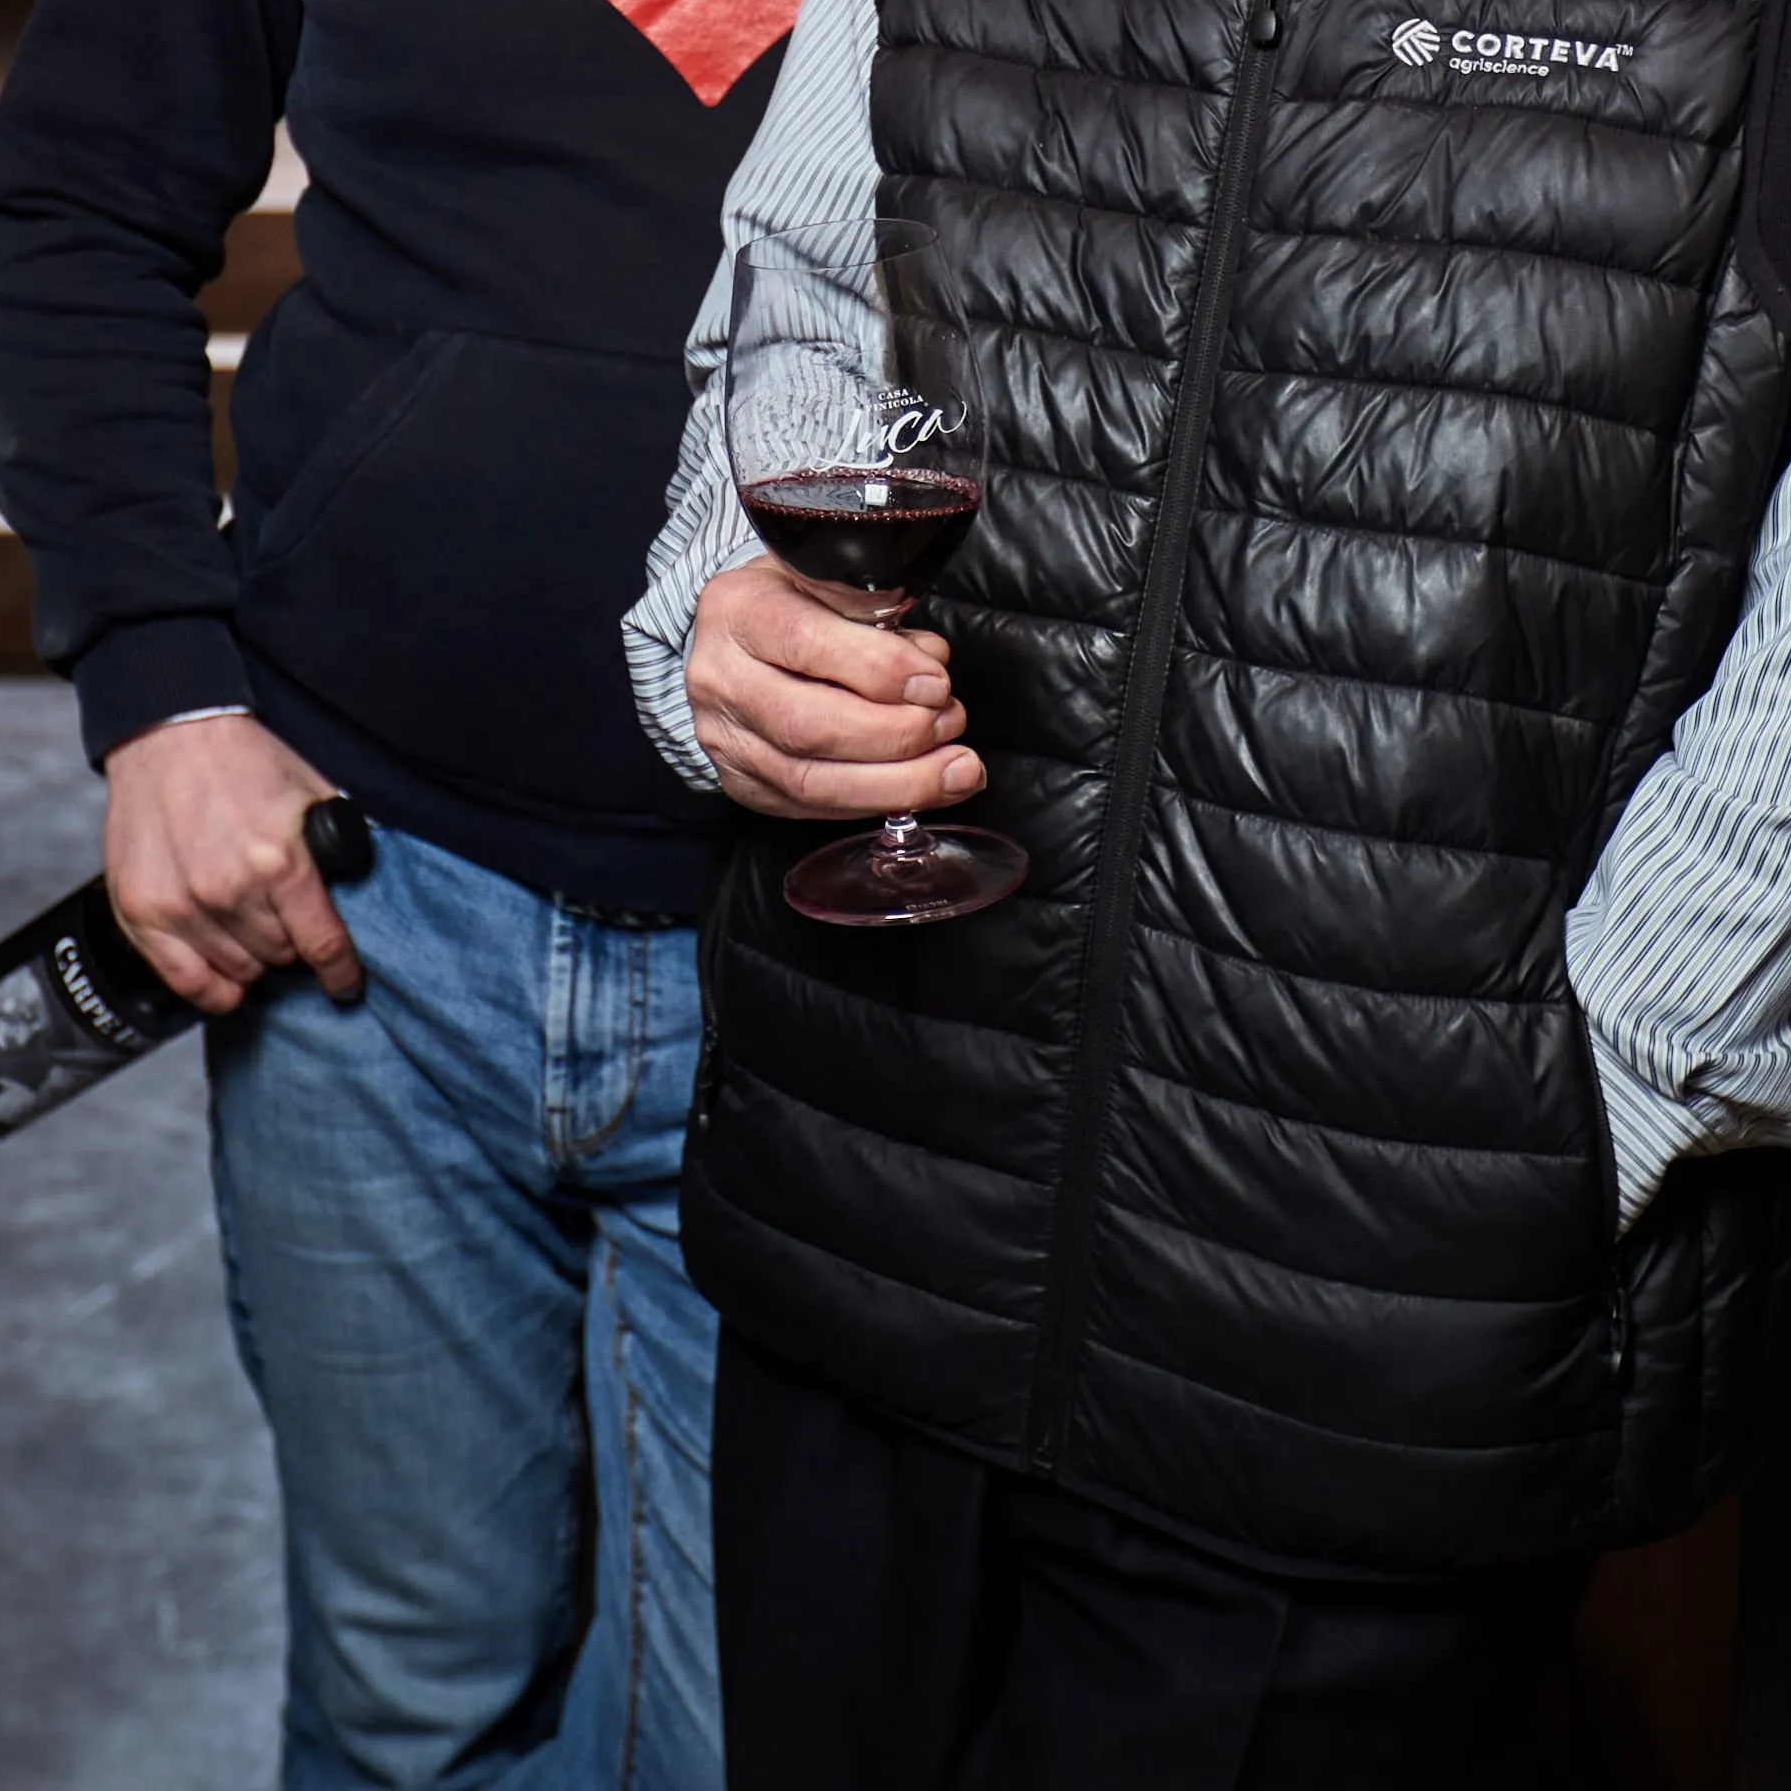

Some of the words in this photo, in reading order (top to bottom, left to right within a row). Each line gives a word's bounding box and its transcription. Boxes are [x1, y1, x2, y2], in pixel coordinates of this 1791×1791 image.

[1449, 57, 1550, 77] agriscience
[878, 388, 909, 401] CASA
[54, 936, 122, 1035] CARPE
